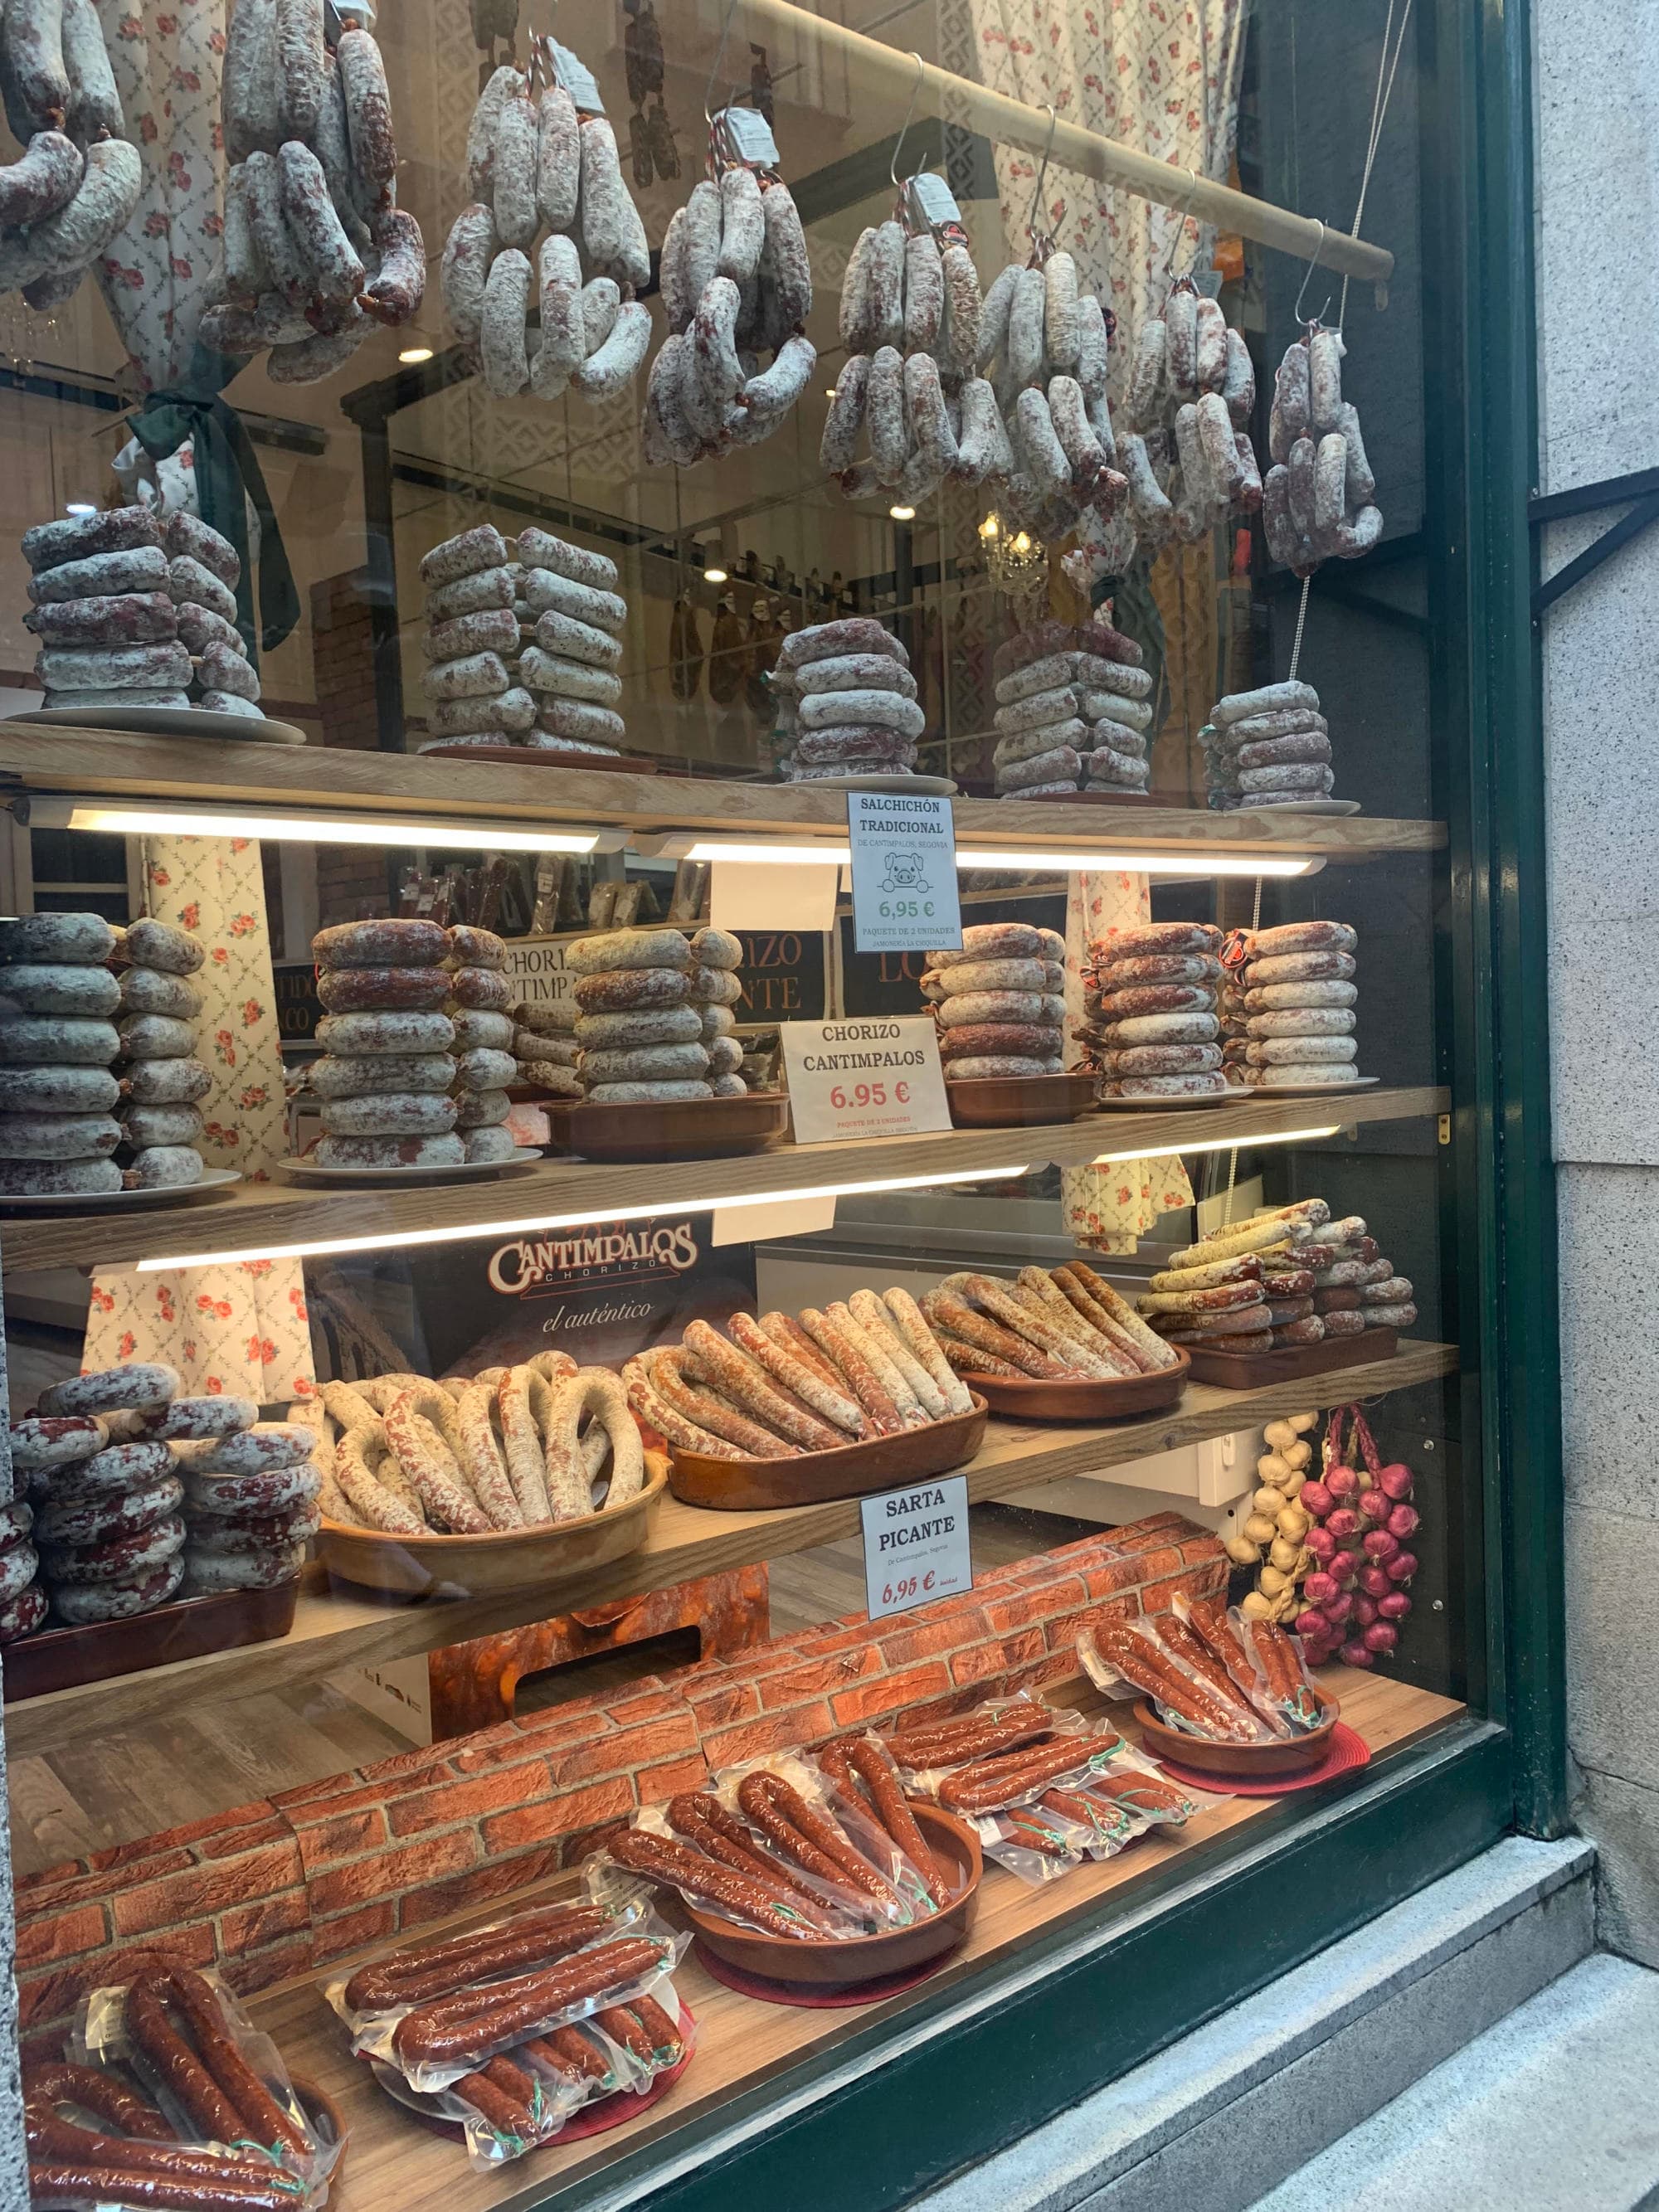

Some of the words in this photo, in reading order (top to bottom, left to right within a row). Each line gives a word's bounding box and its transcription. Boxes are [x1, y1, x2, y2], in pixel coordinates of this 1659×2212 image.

[861, 798, 940, 813] SALCHICHÓN
[859, 819, 944, 834] TRADICIONAL
[878, 900, 919, 920] 6,95
[923, 901, 936, 916] €
[863, 928, 897, 936] PAQUETE
[917, 926, 956, 935] UNIDADES
[503, 948, 572, 975] CHORI
[740, 934, 802, 969] IZO
[822, 1023, 901, 1042] CHORIZO
[803, 1050, 926, 1072] CANTIMPALOS
[830, 1082, 888, 1110] 6.95
[894, 1081, 911, 1104] €
[488, 1222, 698, 1294] CANTIMPALOS
[545, 1259, 655, 1282] CHORIZO
[542, 1305, 566, 1333] el
[564, 1299, 654, 1330] auténtico
[886, 1489, 946, 1518] SARTA
[879, 1515, 956, 1552] PICANTE
[882, 1576, 917, 1605] 6,95
[922, 1569, 936, 1591] €
